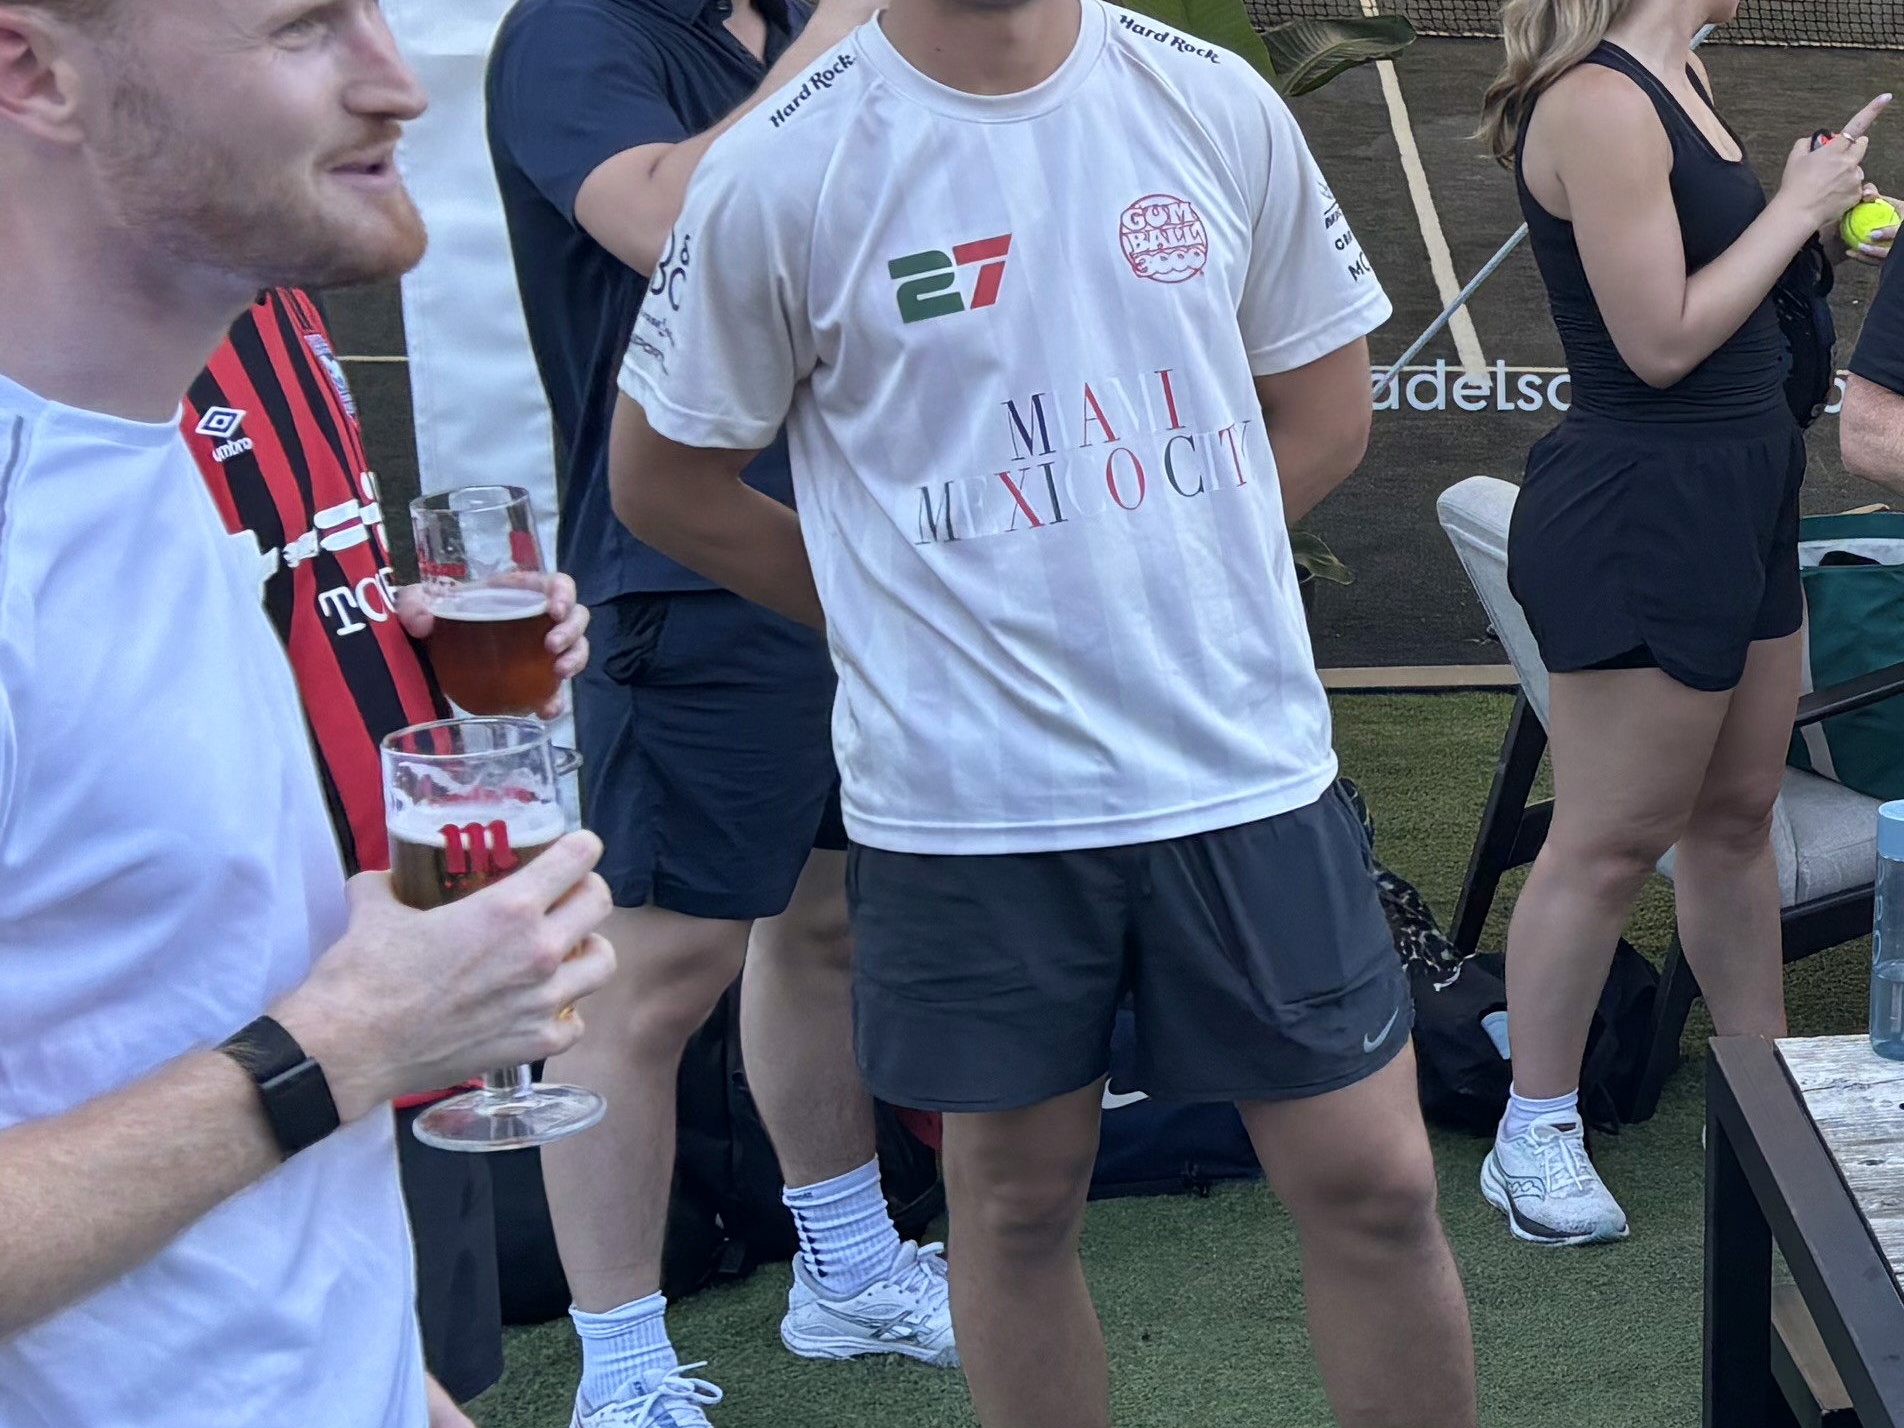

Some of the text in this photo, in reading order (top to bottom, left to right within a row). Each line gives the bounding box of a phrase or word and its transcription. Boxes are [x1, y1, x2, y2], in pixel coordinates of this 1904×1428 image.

[1119, 14, 1222, 64] Hard Rock
[768, 53, 858, 128] Hard Rock
[1121, 202, 1197, 231] GUM
[1127, 222, 1205, 254] BALL
[887, 233, 1013, 324] 27
[212, 437, 254, 462] umbro
